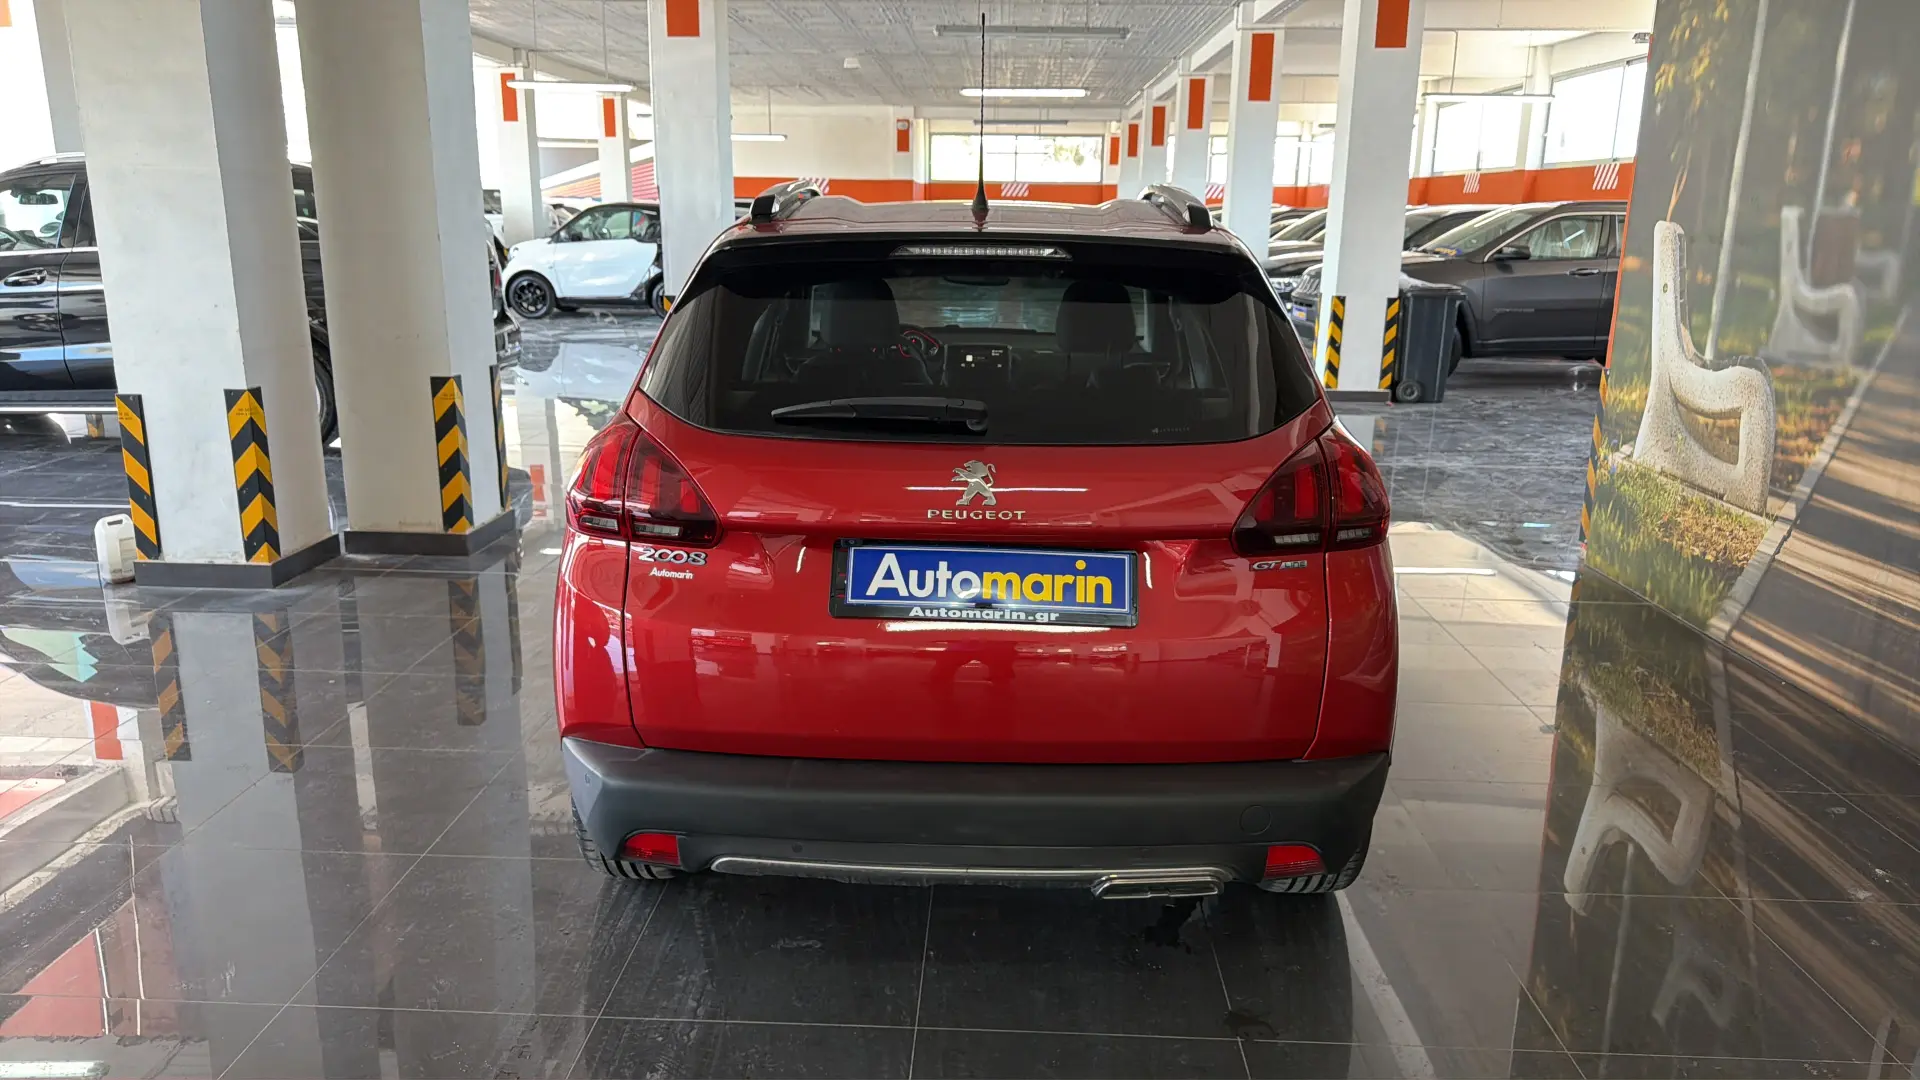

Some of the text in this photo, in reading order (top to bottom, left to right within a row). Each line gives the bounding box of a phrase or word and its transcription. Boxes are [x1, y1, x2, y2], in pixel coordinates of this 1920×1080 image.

[927, 508, 1026, 520] PEUGEOT
[638, 547, 708, 566] 2008
[1252, 560, 1282, 570] GT
[649, 567, 694, 579] Automarin
[865, 552, 1112, 605] Automarin
[908, 606, 1060, 623] Automarin.gr
